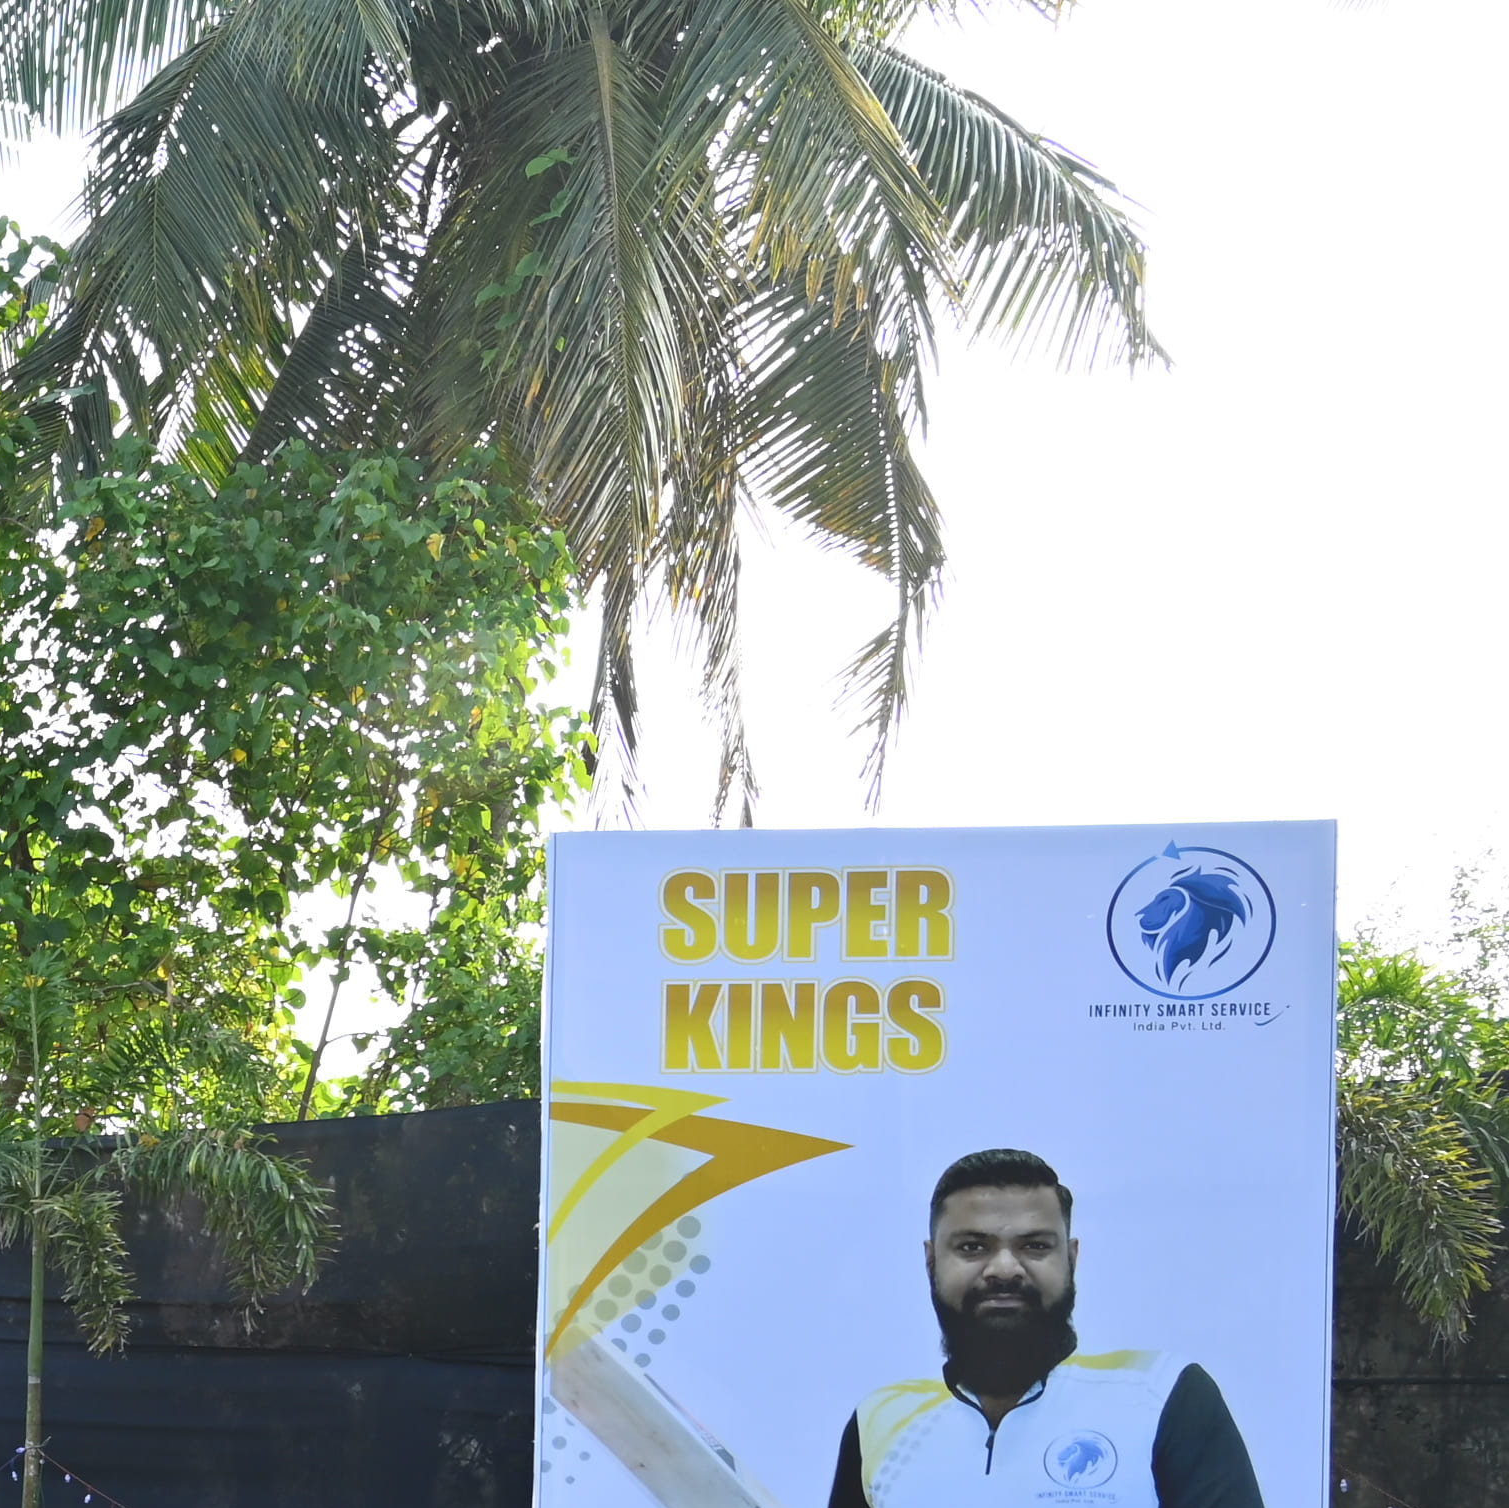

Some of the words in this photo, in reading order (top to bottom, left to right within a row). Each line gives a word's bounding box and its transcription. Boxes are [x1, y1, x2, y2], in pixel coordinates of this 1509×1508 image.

[661, 868, 953, 963] SUPER
[663, 978, 945, 1073] KINGS
[1088, 1003, 1151, 1018] INFINITY
[1156, 1003, 1205, 1017] SMART
[1211, 1002, 1271, 1016] SERVICE
[1133, 1021, 1165, 1031] India
[1171, 1021, 1196, 1031] Pvt.
[1201, 1020, 1226, 1031] Ltd.
